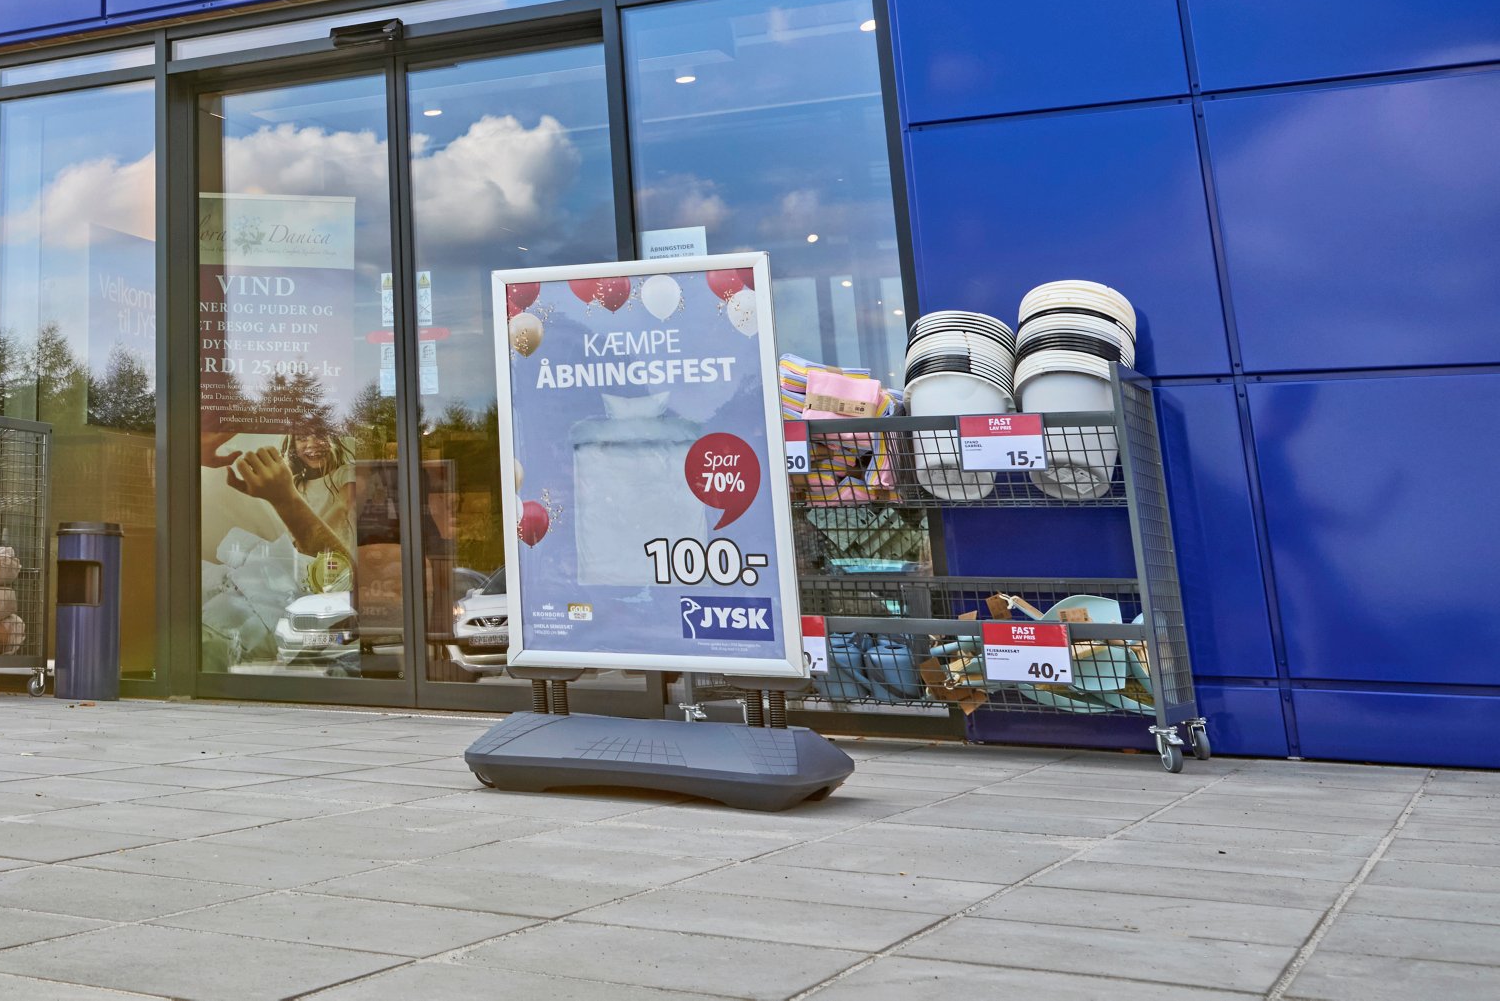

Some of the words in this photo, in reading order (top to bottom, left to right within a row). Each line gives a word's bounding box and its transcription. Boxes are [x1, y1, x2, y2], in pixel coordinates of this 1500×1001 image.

[267, 224, 331, 245] Danica
[215, 274, 296, 297] VIND
[233, 302, 253, 314] OG
[260, 304, 307, 315] PUDER
[312, 305, 333, 317] OG
[218, 320, 264, 333] BESØG
[268, 322, 286, 334] AF
[291, 323, 318, 334] DIN
[203, 338, 310, 353] DYNE-EKSPERT
[584, 329, 681, 357] KÆMPE
[200, 357, 244, 374] RDI
[252, 359, 319, 376] 25.000,-
[323, 360, 342, 377] kr
[536, 357, 736, 389] ÅBNINGSFEST
[988, 418, 1012, 426] FAST
[703, 451, 740, 470] Spar
[1006, 450, 1042, 467] 15,-
[701, 471, 746, 493] 70%
[643, 537, 768, 586] 100.-
[700, 606, 770, 630] JYSK
[1011, 626, 1035, 635] FAST
[1027, 662, 1067, 682] 40,-
